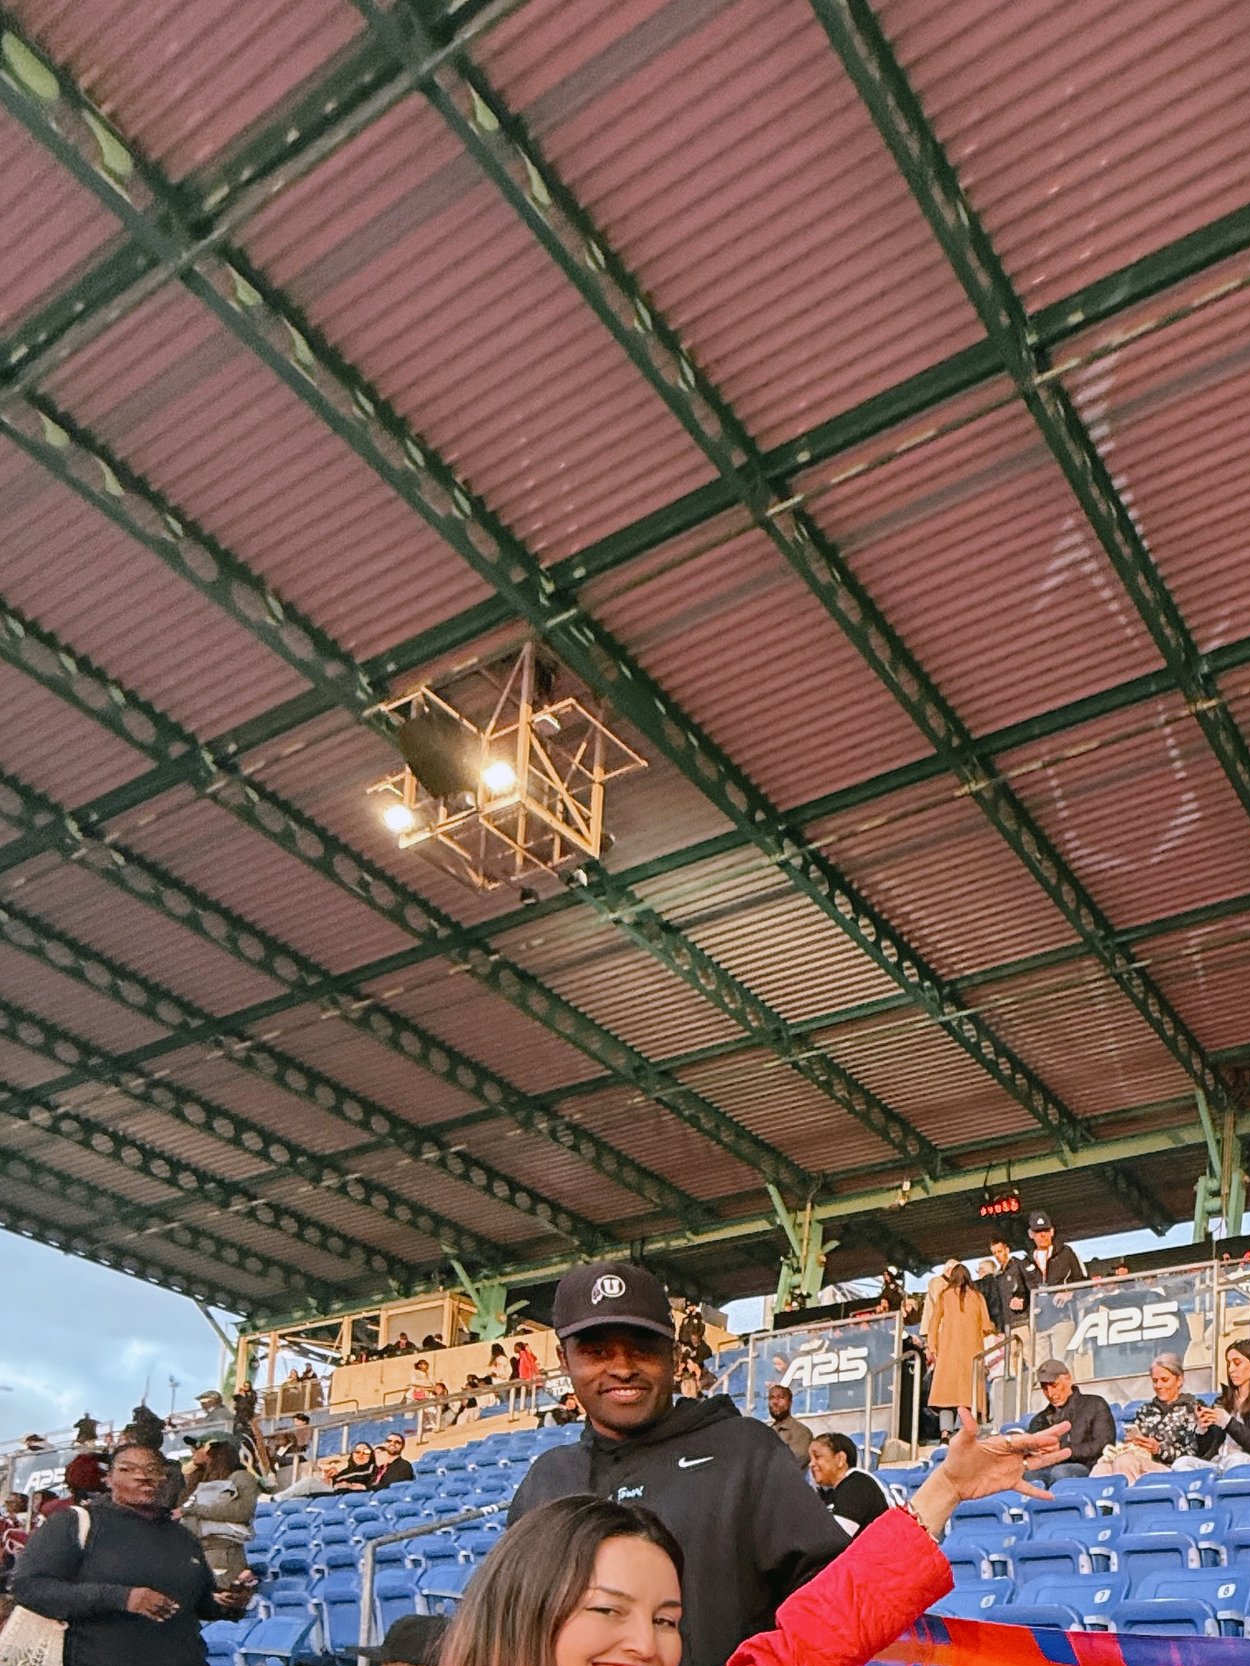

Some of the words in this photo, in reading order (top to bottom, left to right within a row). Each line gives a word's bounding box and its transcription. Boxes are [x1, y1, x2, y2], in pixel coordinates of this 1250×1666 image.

[602, 1279, 620, 1294] U
[1066, 1301, 1180, 1351] A25
[780, 1346, 869, 1388] A25
